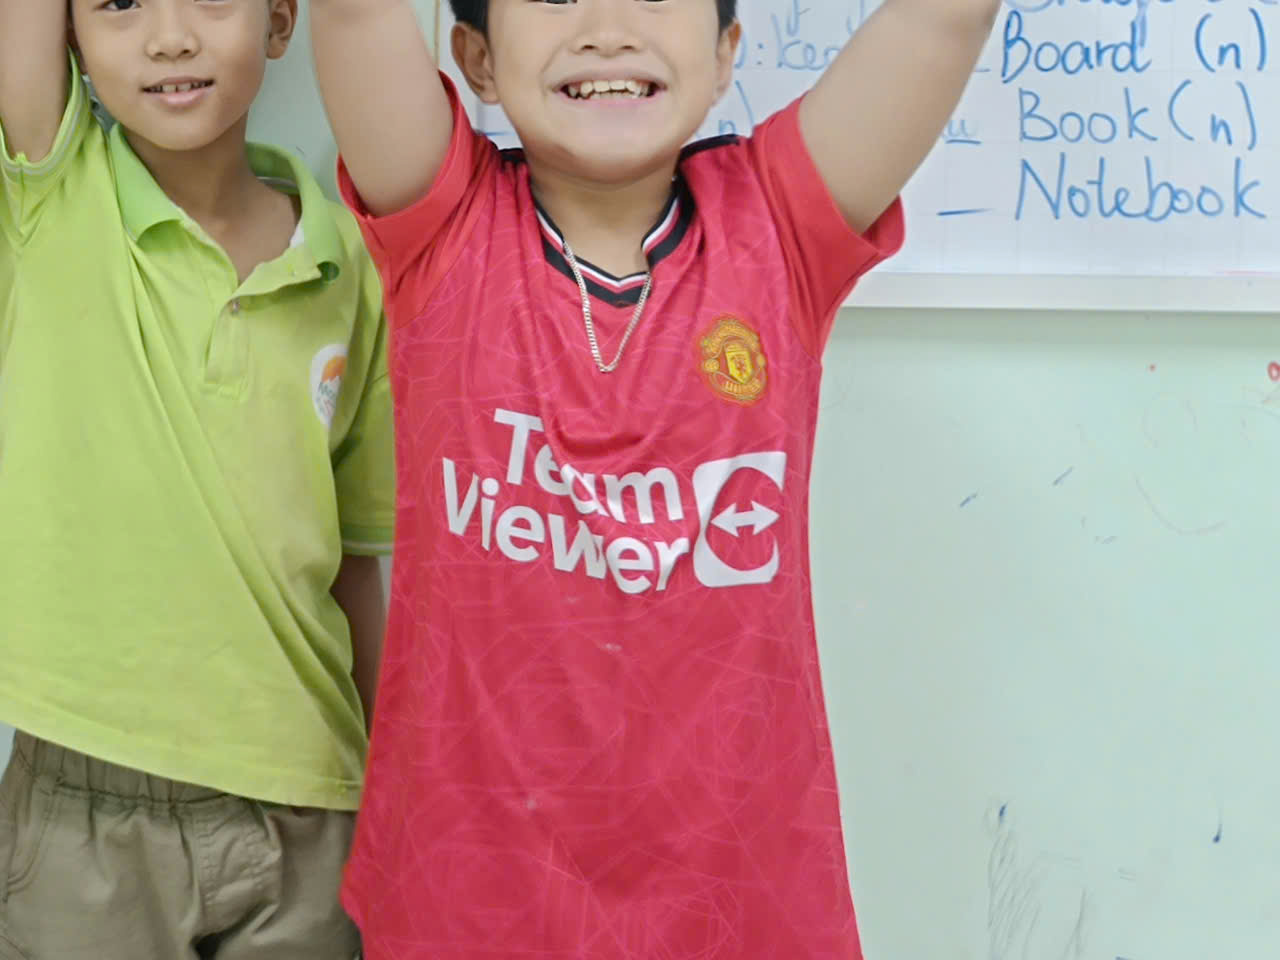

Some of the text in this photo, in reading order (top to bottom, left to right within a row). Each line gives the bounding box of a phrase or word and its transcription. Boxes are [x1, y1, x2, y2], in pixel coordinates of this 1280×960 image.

[1000, 7, 1153, 84] Board
[1017, 86, 1159, 144] Book
[1014, 151, 1268, 223] Notebook
[493, 407, 685, 525] Team
[442, 456, 690, 595] Viewer
